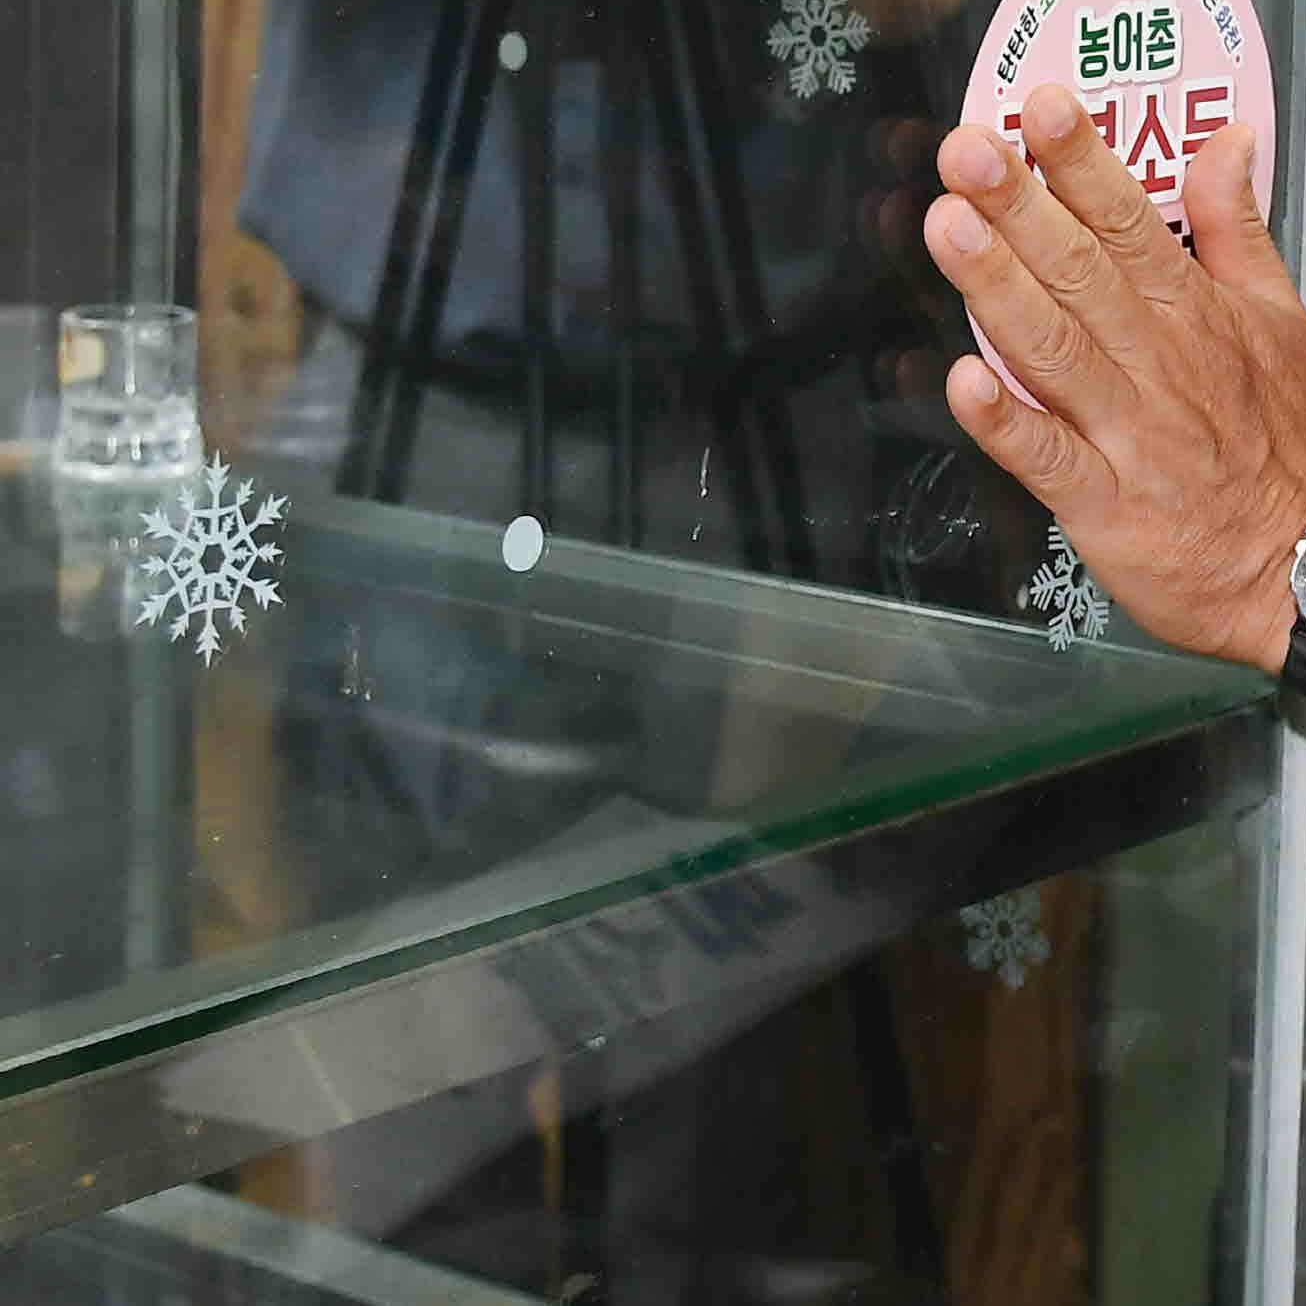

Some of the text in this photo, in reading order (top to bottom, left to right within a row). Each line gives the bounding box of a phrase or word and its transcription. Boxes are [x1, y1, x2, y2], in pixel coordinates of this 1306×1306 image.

[996, 4, 1040, 85] 탄탄한
[1214, 4, 1242, 55] 화천
[1078, 6, 1176, 80] 농어촌
